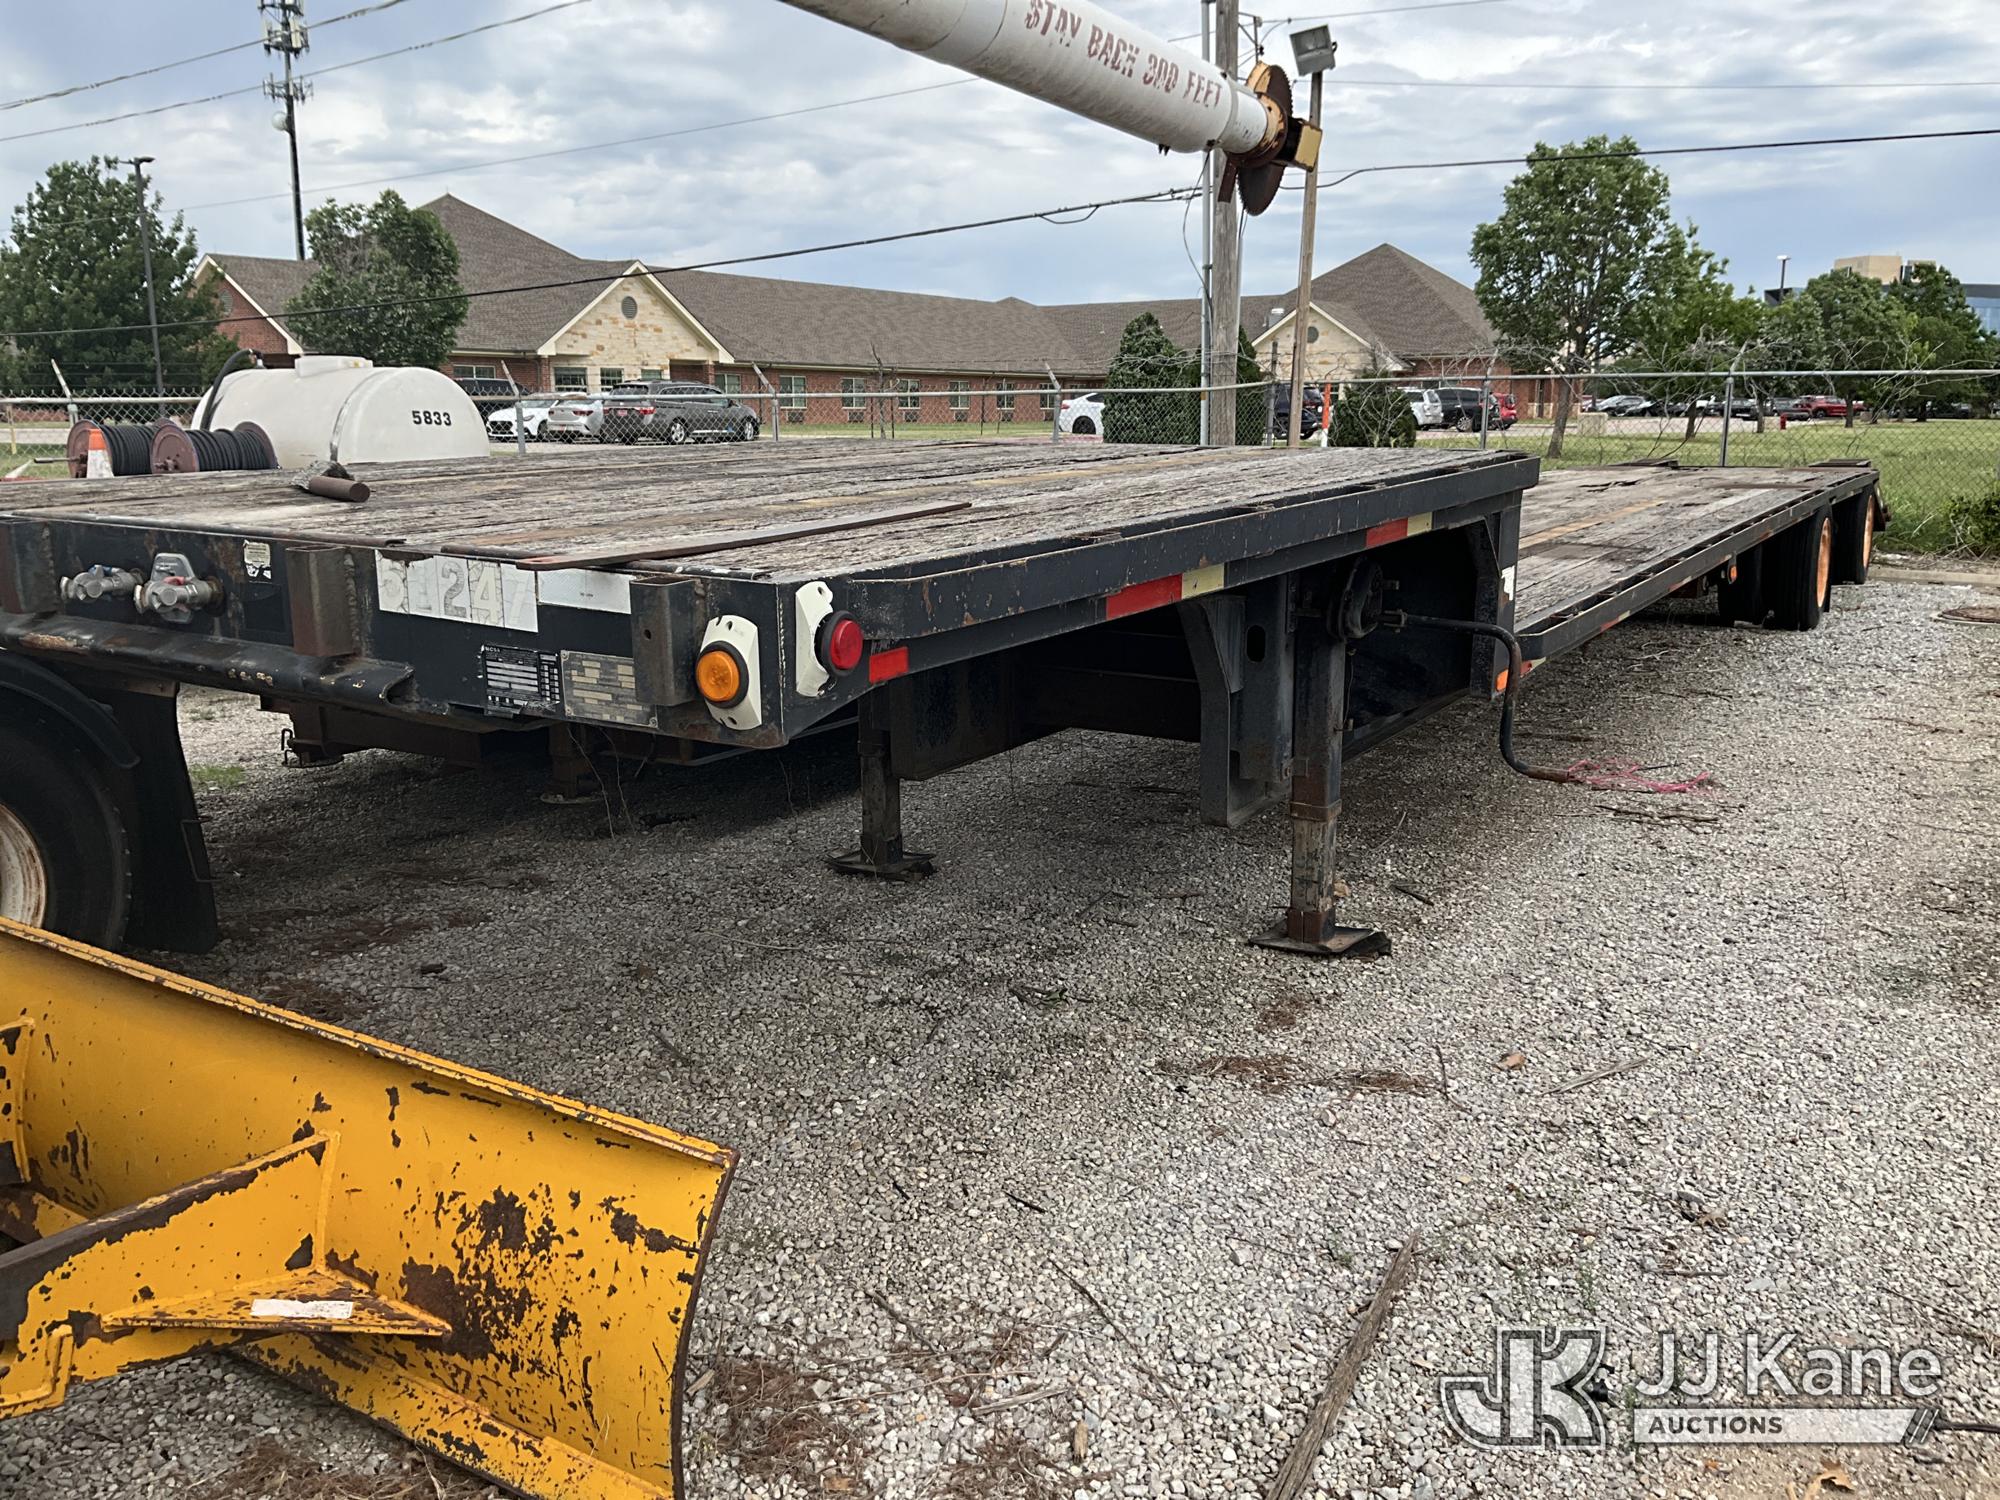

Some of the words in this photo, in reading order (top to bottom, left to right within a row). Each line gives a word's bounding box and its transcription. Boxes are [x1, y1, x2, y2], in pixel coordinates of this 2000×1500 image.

[1024, 0, 1082, 40] STAY
[1087, 24, 1140, 78] BACK
[1142, 53, 1180, 93] 300
[1182, 70, 1223, 109] FEET
[412, 410, 452, 426] 5833
